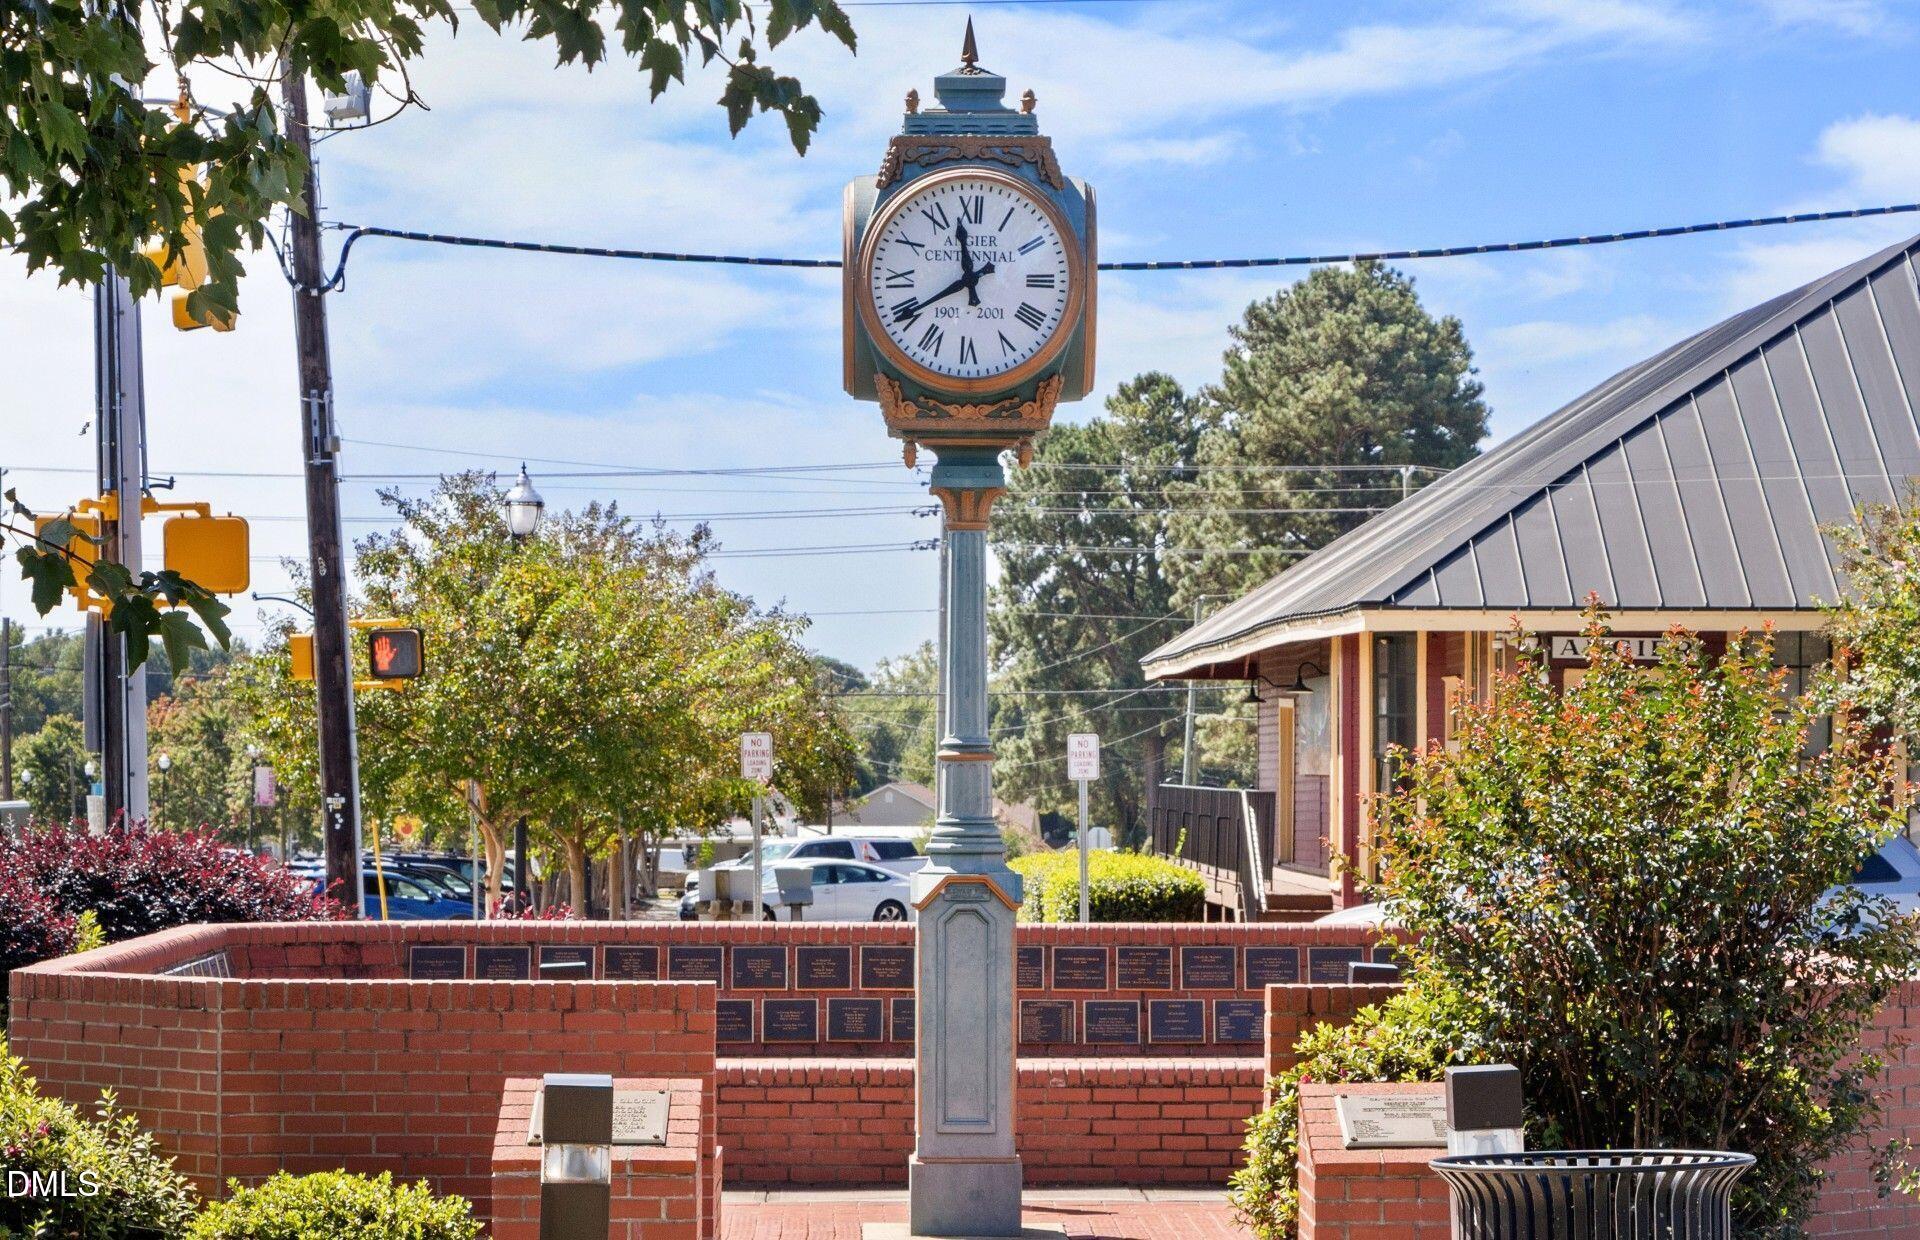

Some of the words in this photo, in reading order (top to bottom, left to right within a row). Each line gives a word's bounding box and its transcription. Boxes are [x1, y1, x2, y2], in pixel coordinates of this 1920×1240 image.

[959, 195, 984, 224] XII
[921, 202, 950, 235] XI
[895, 231, 925, 257] X
[925, 249, 1016, 263] CENTNNIAL
[885, 268, 915, 289] IX
[1026, 274, 1054, 289] III
[935, 306, 960, 318] 1901
[977, 307, 1004, 319] 2001
[997, 330, 1017, 357] V
[1560, 639, 1692, 657] AGIER
[750, 738, 762, 747] NO
[1077, 740, 1089, 748] NO
[744, 749, 770, 758] PARKING
